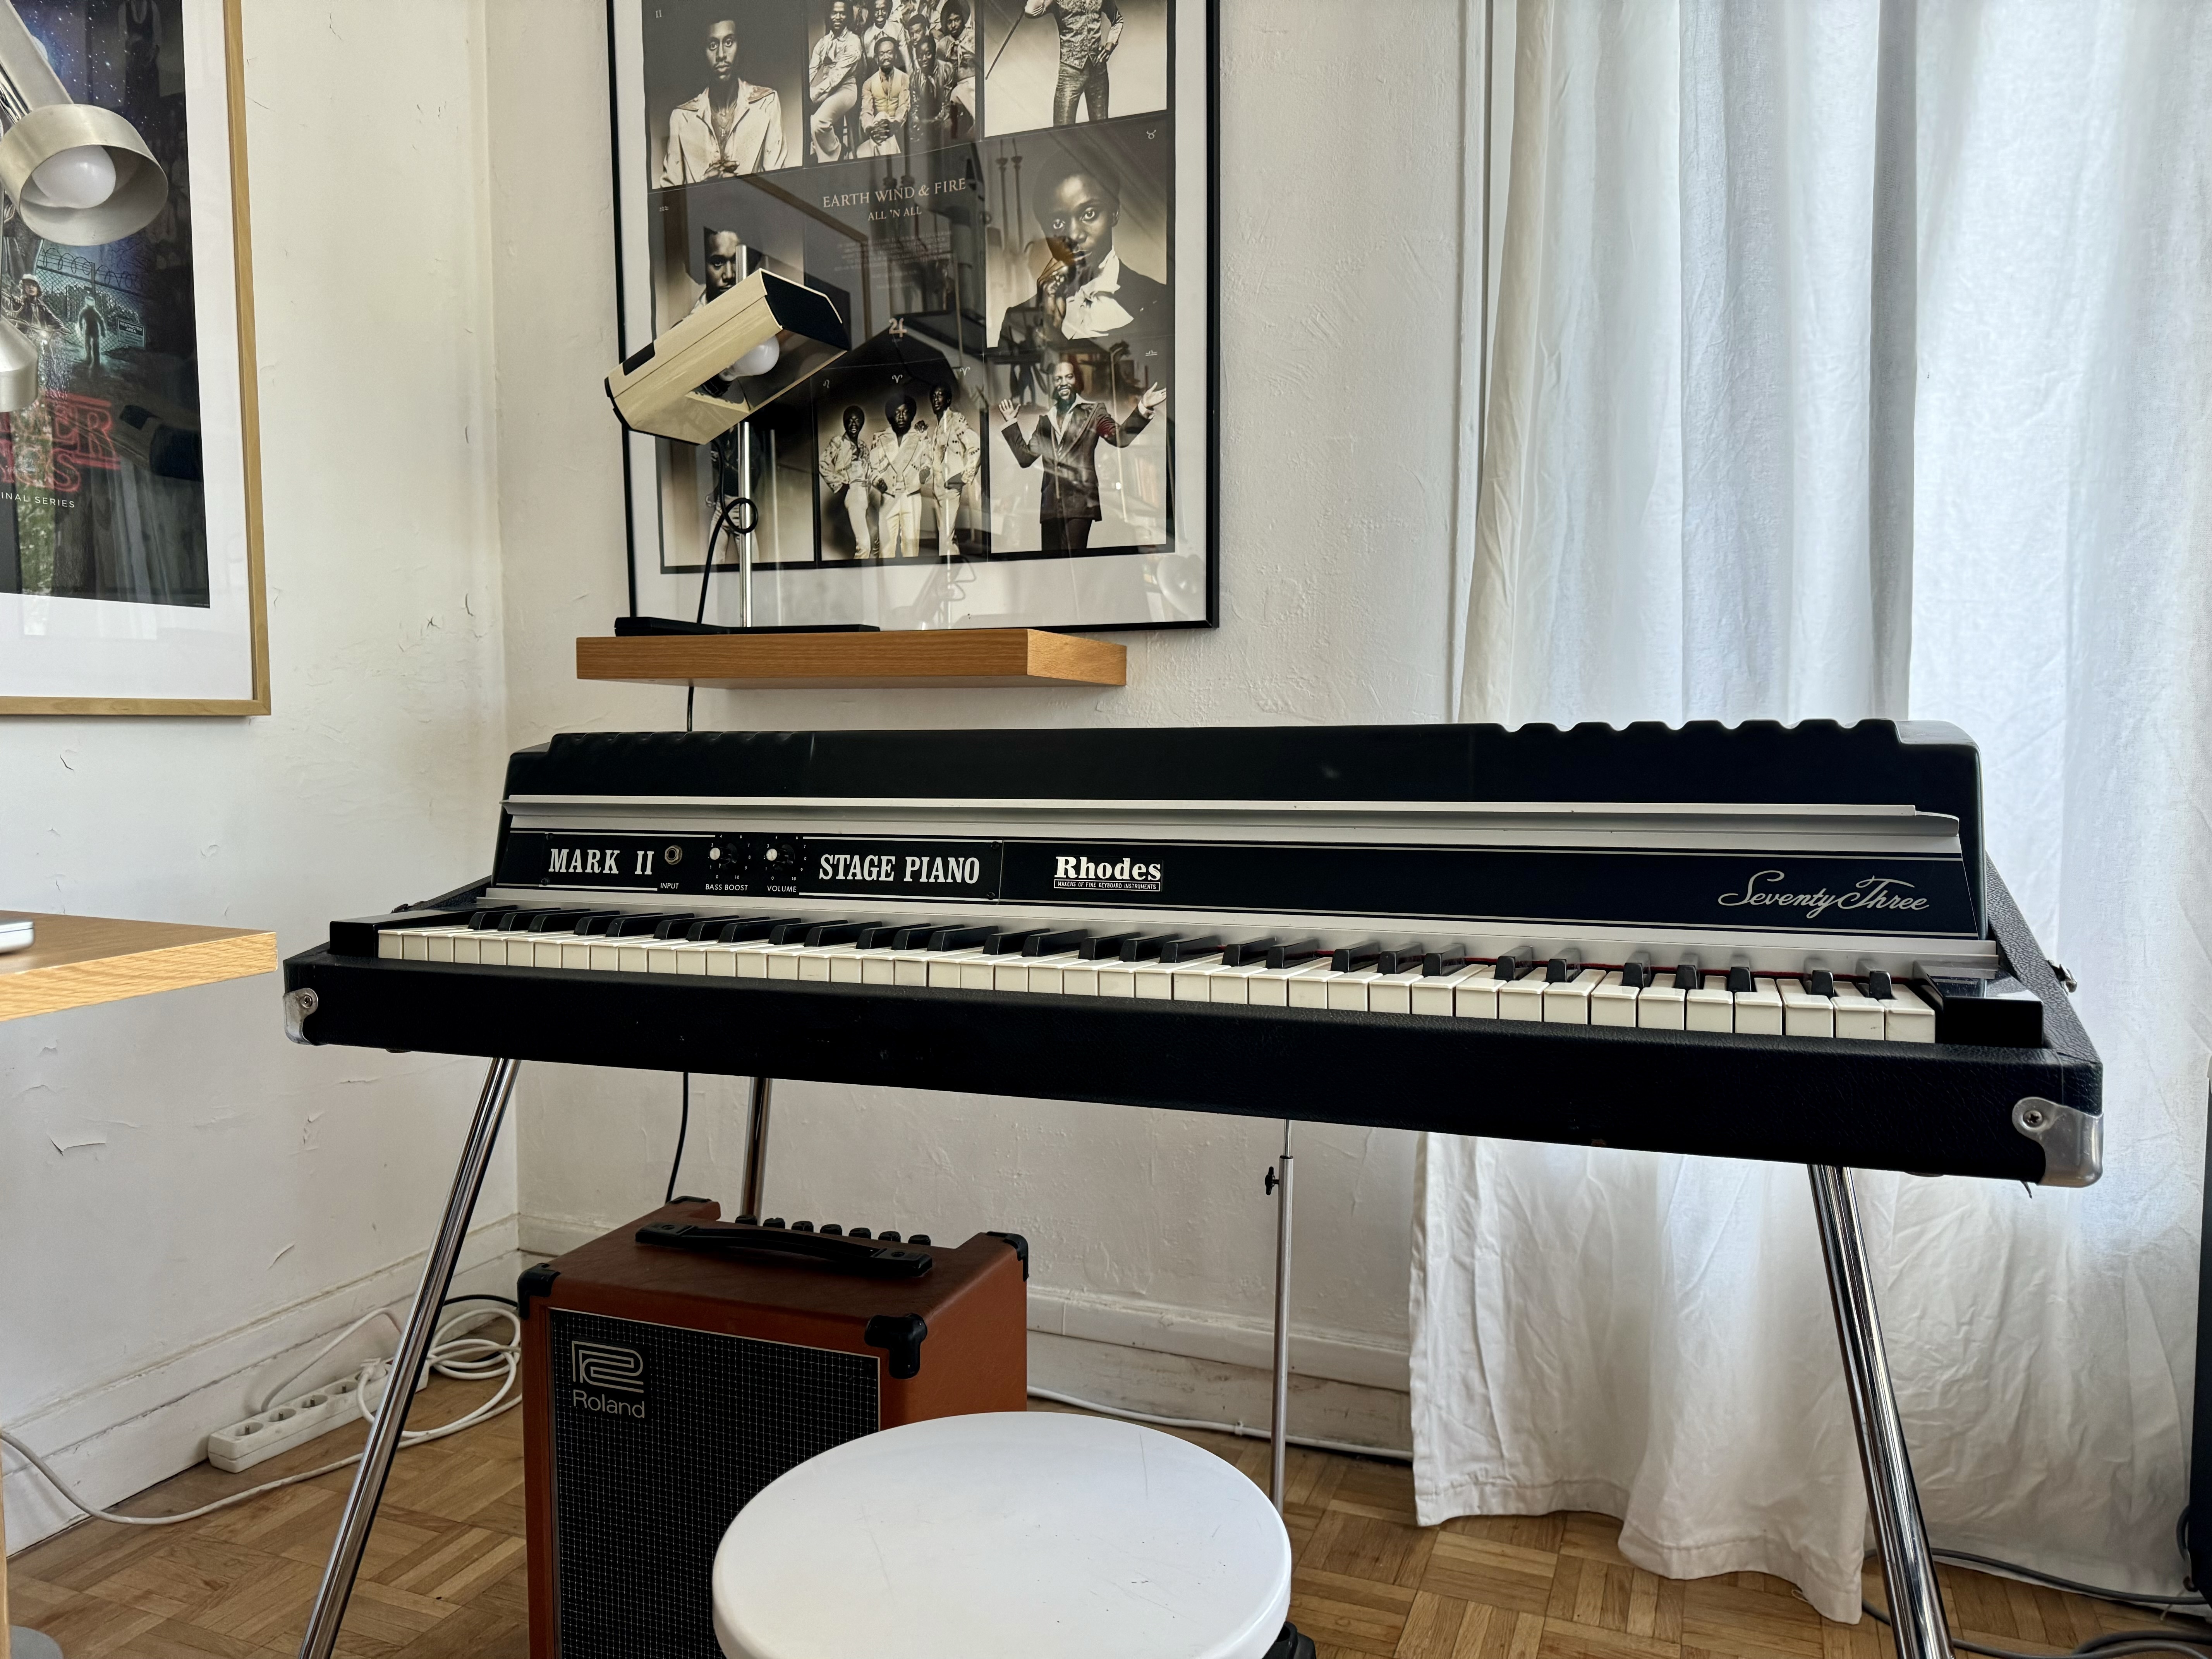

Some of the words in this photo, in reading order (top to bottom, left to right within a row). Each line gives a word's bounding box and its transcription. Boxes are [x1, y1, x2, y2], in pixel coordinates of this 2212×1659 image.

[823, 192, 870, 208] EARTH
[874, 186, 915, 202] WIND
[918, 185, 930, 196] &
[934, 178, 966, 194] FIRE
[868, 211, 887, 221] ALL
[903, 206, 922, 217] ALL
[34, 496, 75, 508] SERIES
[548, 848, 620, 874] MARK
[634, 851, 654, 875] II
[819, 854, 896, 881] STAGE
[903, 856, 979, 884] PIANO
[1054, 856, 1161, 881] Rhodes
[1718, 870, 1838, 919] Seventy
[1837, 875, 1930, 910] Three
[573, 1389, 645, 1418] Roland
